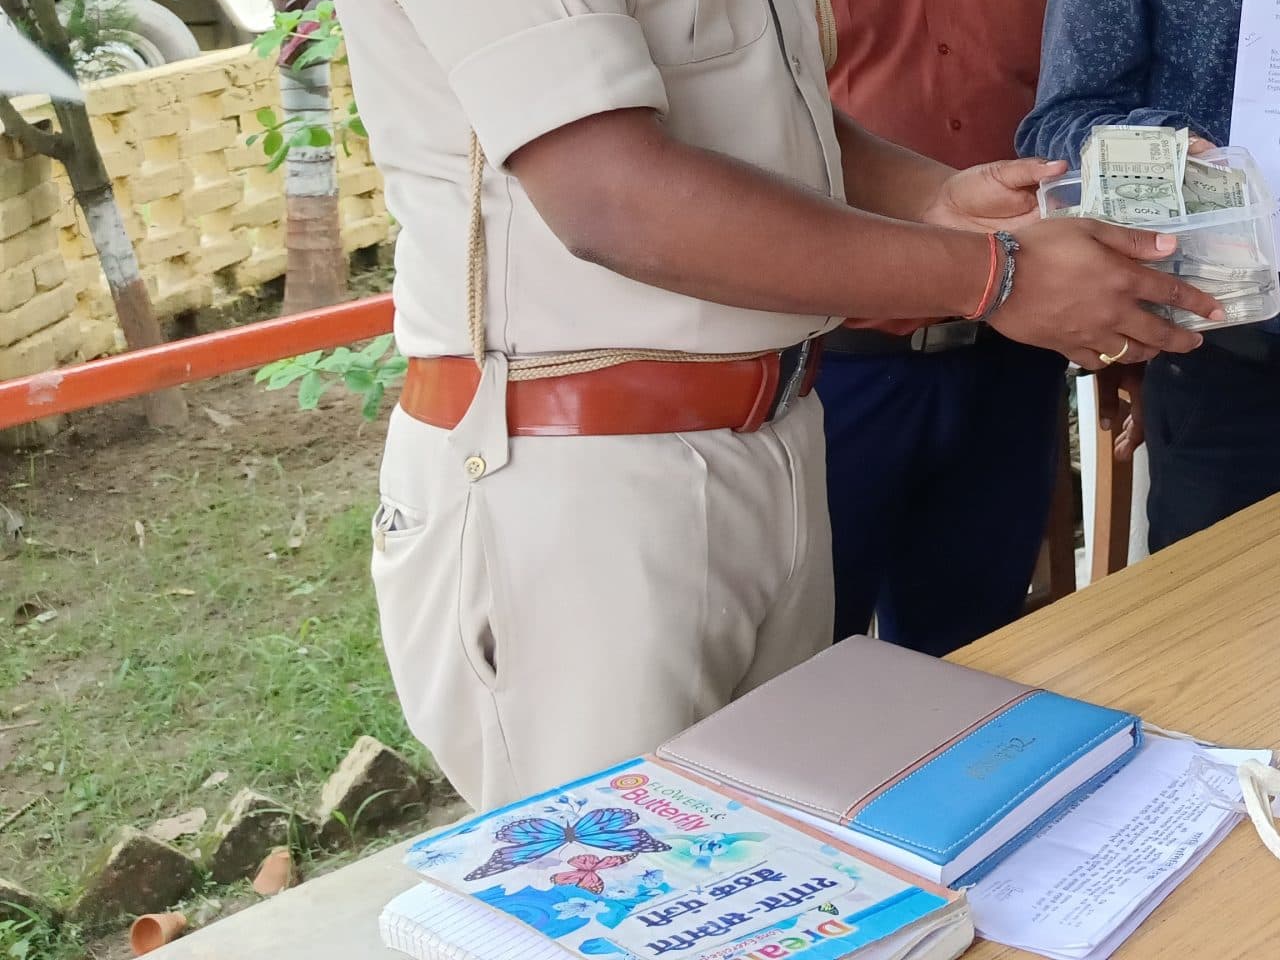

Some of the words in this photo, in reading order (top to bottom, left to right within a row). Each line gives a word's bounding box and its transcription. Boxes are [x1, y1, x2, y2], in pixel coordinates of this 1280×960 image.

[622, 787, 710, 831] Butterfly
[646, 780, 712, 816] FLOWERS
[708, 867, 787, 900] बैठक
[636, 898, 708, 928] पंजी
[643, 874, 838, 956] शांति-समिति
